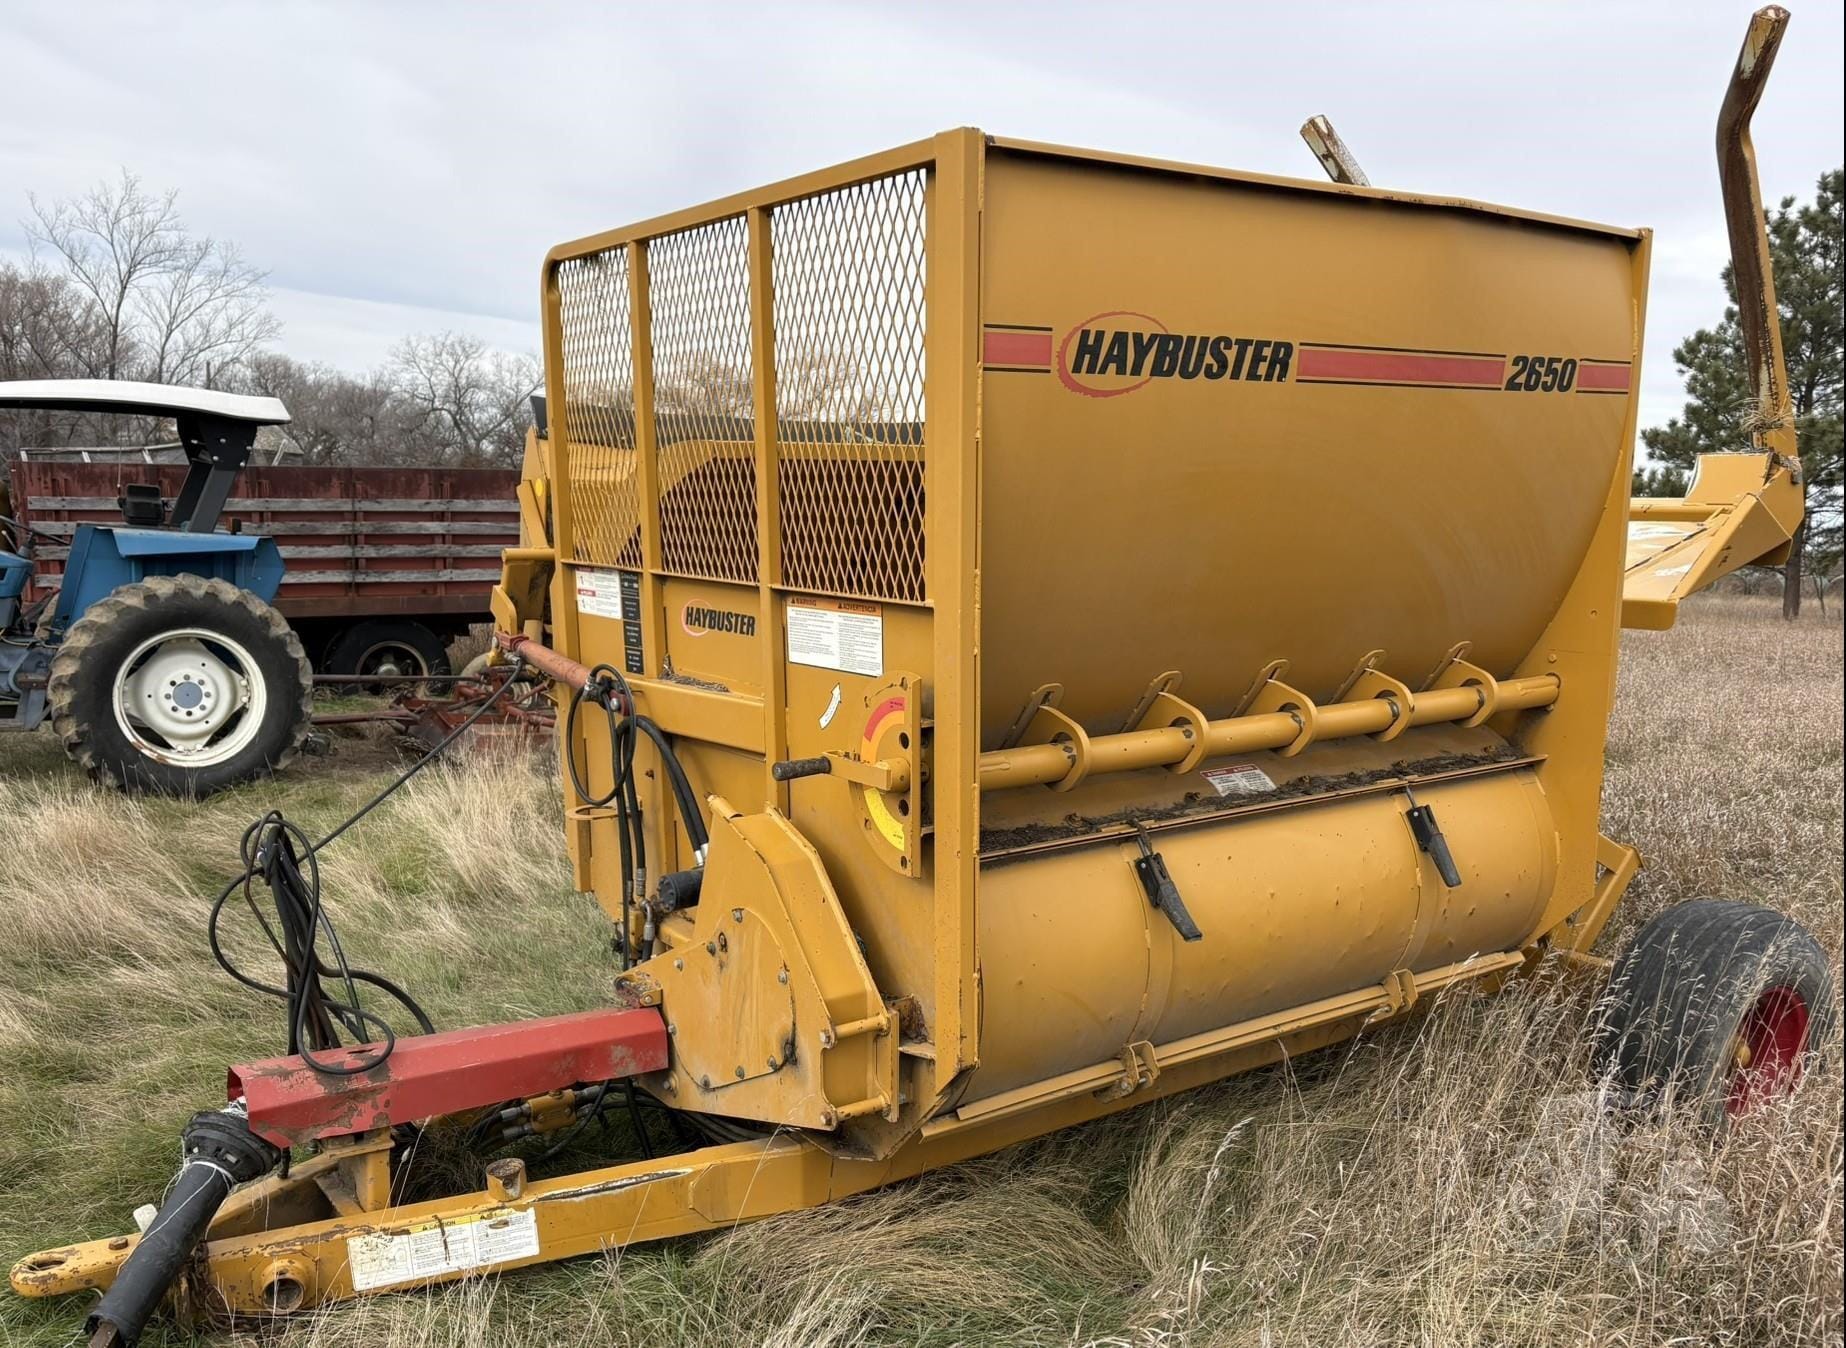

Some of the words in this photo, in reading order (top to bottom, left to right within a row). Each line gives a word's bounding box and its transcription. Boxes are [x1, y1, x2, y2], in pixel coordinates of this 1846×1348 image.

[1072, 329, 1293, 382] HAYBUSTER
[1504, 355, 1577, 392] 2650
[686, 606, 756, 637] HAYBUSTER
[429, 1219, 456, 1230] CAION
